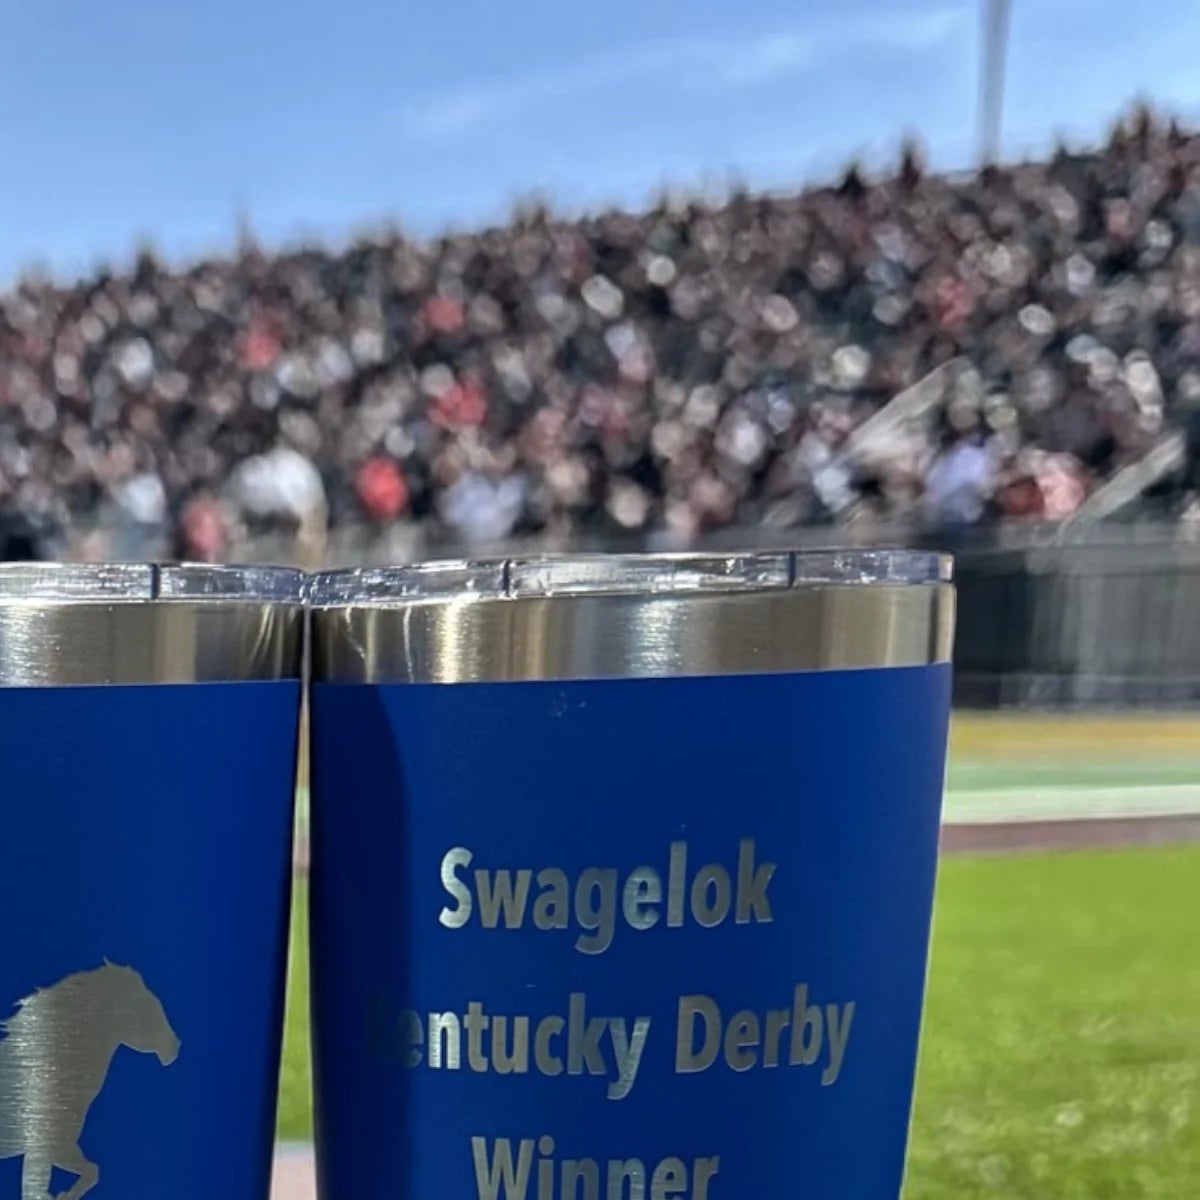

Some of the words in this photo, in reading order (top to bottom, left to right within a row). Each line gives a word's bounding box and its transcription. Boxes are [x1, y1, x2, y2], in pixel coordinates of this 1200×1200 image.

[438, 838, 776, 955] Swagelok
[367, 990, 650, 1100] entucky
[674, 983, 856, 1086] Derby
